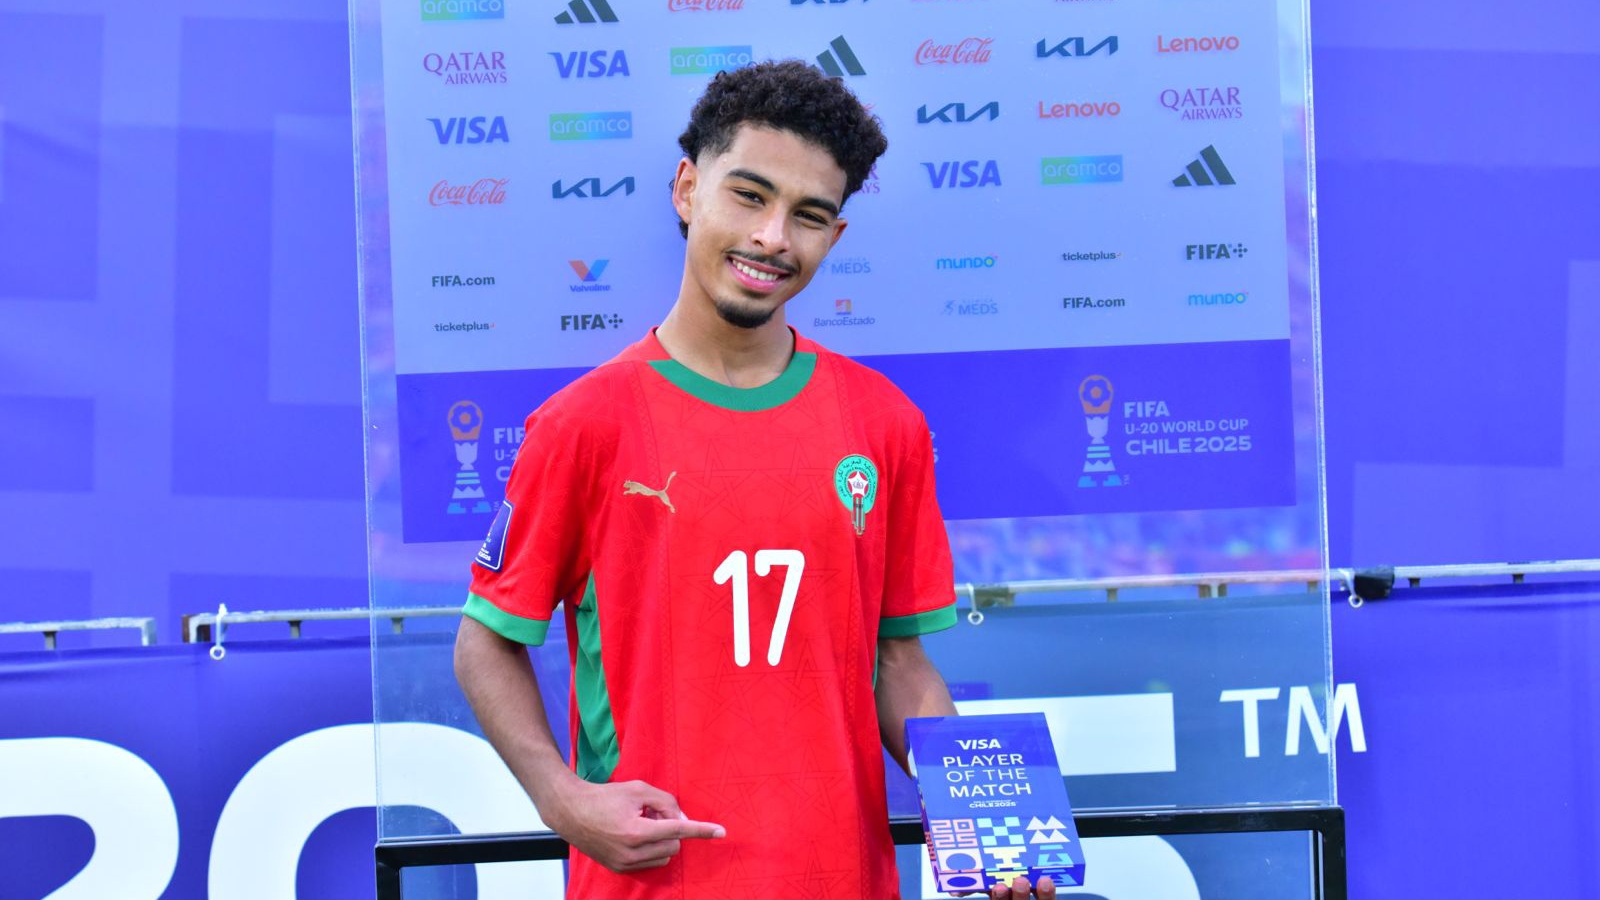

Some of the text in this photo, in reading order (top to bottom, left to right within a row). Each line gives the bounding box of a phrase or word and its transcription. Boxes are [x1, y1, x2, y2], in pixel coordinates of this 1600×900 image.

[915, 38, 994, 65] Coca-Cola
[1037, 36, 1118, 58] KIA
[1157, 35, 1239, 53] Lenovo
[423, 52, 506, 75] QATAR
[547, 50, 630, 78] VISA
[673, 51, 749, 69] aramco
[444, 72, 507, 84] AIRWAYS
[1160, 87, 1240, 111] QATAR
[917, 102, 999, 124] KIA
[1039, 101, 1120, 119] Lenovo
[1181, 107, 1242, 121] AIRWAYS
[425, 116, 509, 144] VISA
[552, 117, 630, 134] aramco
[920, 160, 1002, 188] VISA
[1044, 160, 1121, 177] aramco
[428, 178, 510, 206] Coca-Cola
[552, 177, 635, 199] KIA
[1062, 251, 1116, 262] ticketplus
[831, 262, 871, 274] MEDS
[432, 275, 495, 287] FIFA.com
[958, 303, 998, 315] MEDS
[1063, 297, 1125, 309] FIFA.com
[434, 321, 489, 332] ticketplus
[813, 316, 875, 327] BancoEstado
[1124, 401, 1169, 418] FIFA
[493, 427, 525, 444] FIF
[1125, 419, 1249, 435] U-20 WORLD CUP
[713, 549, 806, 667] 17
[1220, 683, 1367, 758] TM
[955, 739, 1001, 749] VISA
[942, 754, 1024, 767] PLAYER
[946, 768, 1028, 782] OF THE
[949, 783, 1032, 797] MATCH
